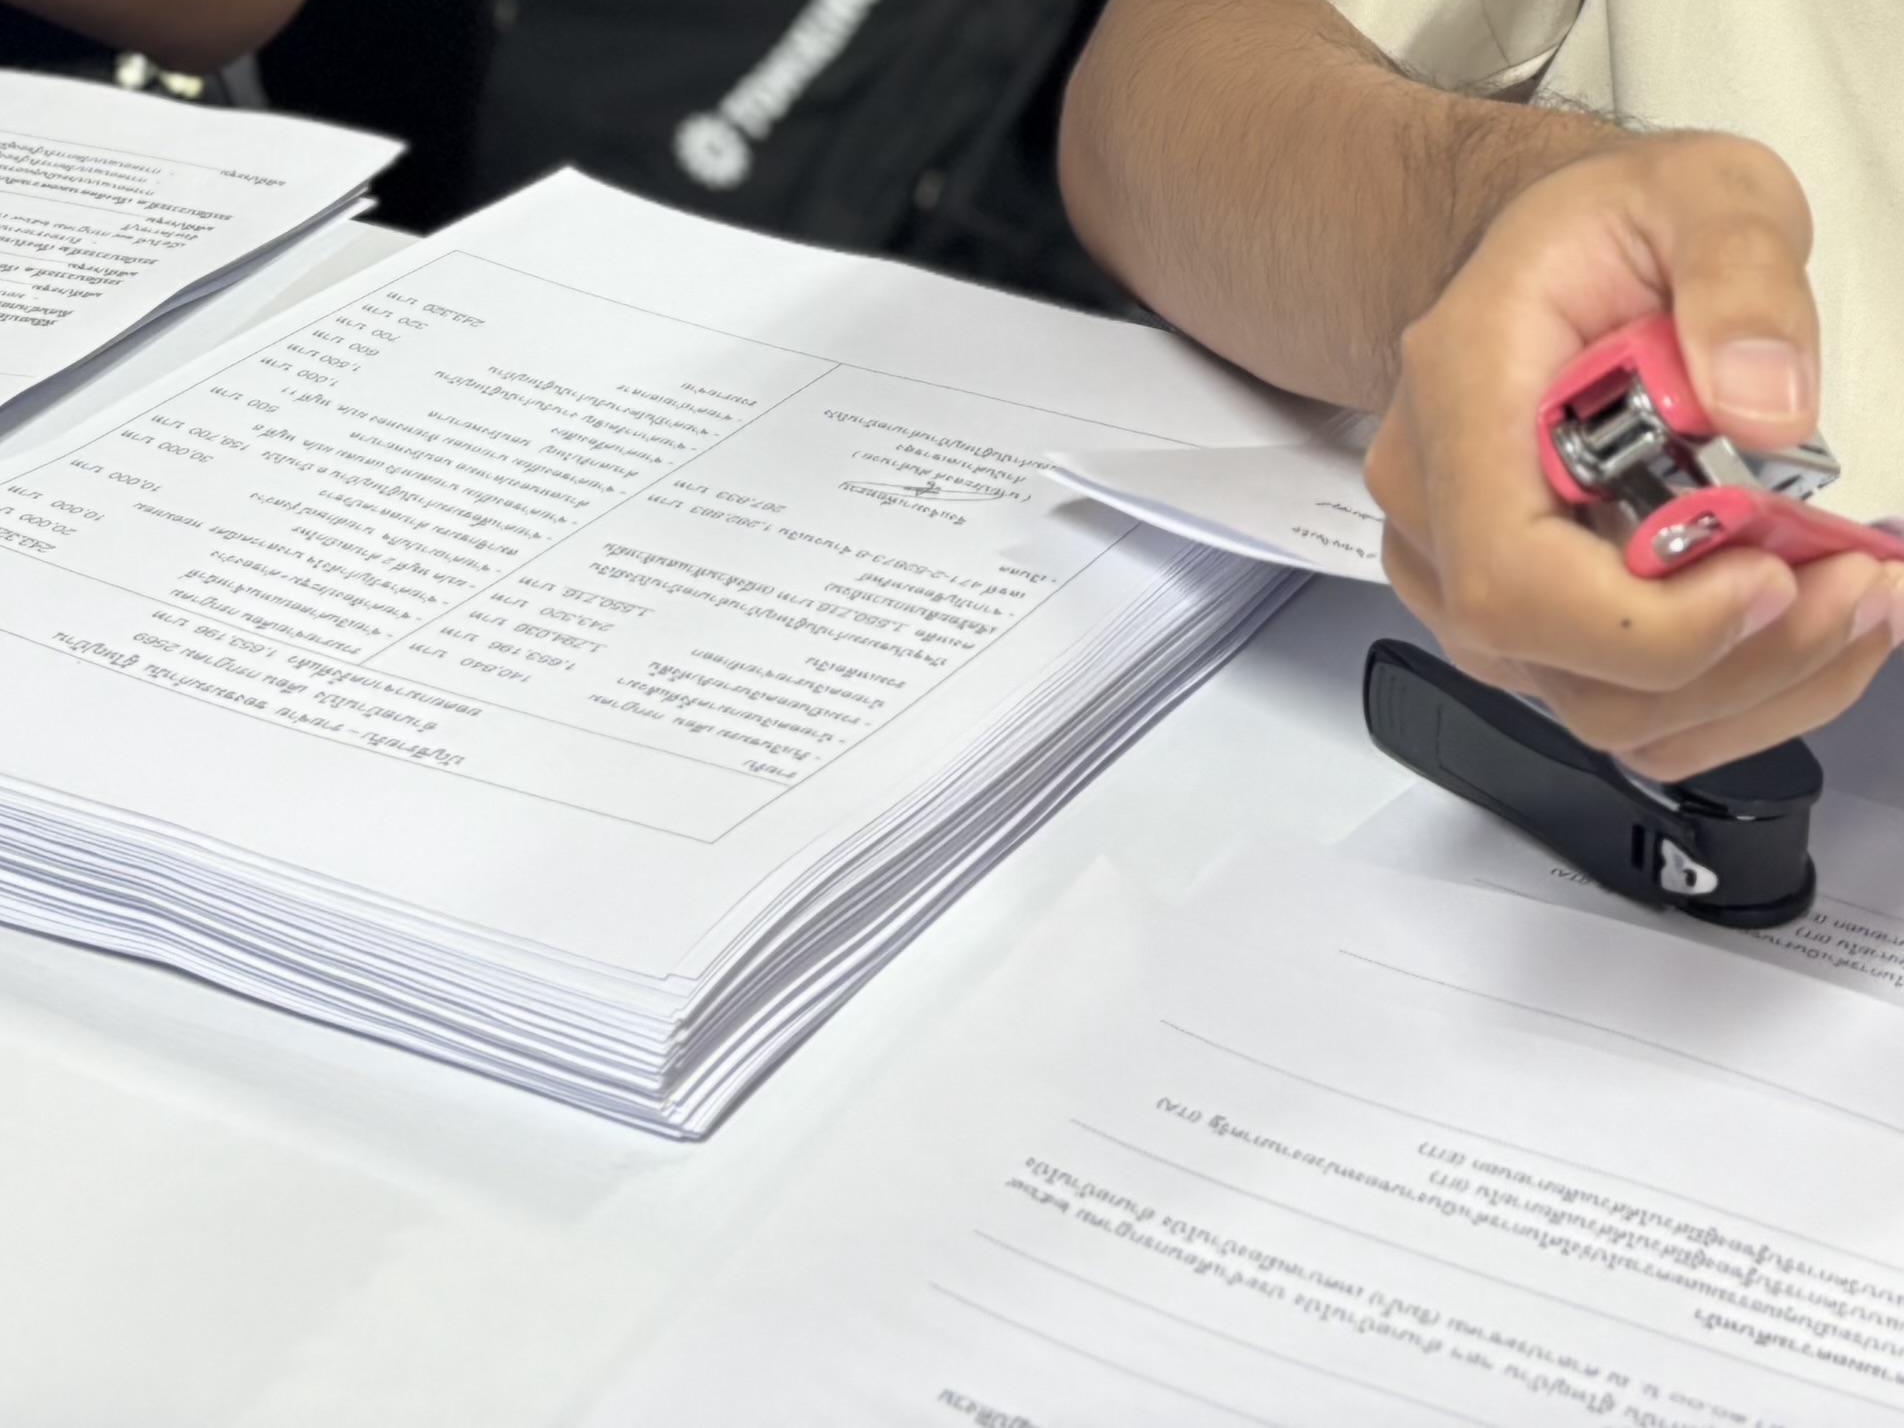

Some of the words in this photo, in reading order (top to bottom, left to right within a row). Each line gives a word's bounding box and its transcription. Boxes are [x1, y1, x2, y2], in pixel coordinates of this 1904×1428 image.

[385, 291, 419, 306] บาท
[361, 303, 394, 319] บาท
[335, 315, 367, 331] บาท
[311, 329, 346, 344] บาท
[286, 343, 321, 358] บาท
[259, 356, 294, 372] บาท
[209, 385, 244, 401] บาท
[150, 414, 186, 430] บาท
[120, 429, 156, 445] บาท
[69, 458, 105, 474] บาท
[7, 485, 44, 500] บาท
[672, 479, 710, 495] บาท
[646, 494, 685, 509] บาท
[517, 576, 557, 592] บาท
[489, 592, 530, 609] บาท
[151, 610, 190, 628] บาท
[468, 610, 508, 627] บาท
[132, 632, 182, 653] 2569
[439, 626, 480, 643] บาท
[408, 642, 449, 659] บาท
